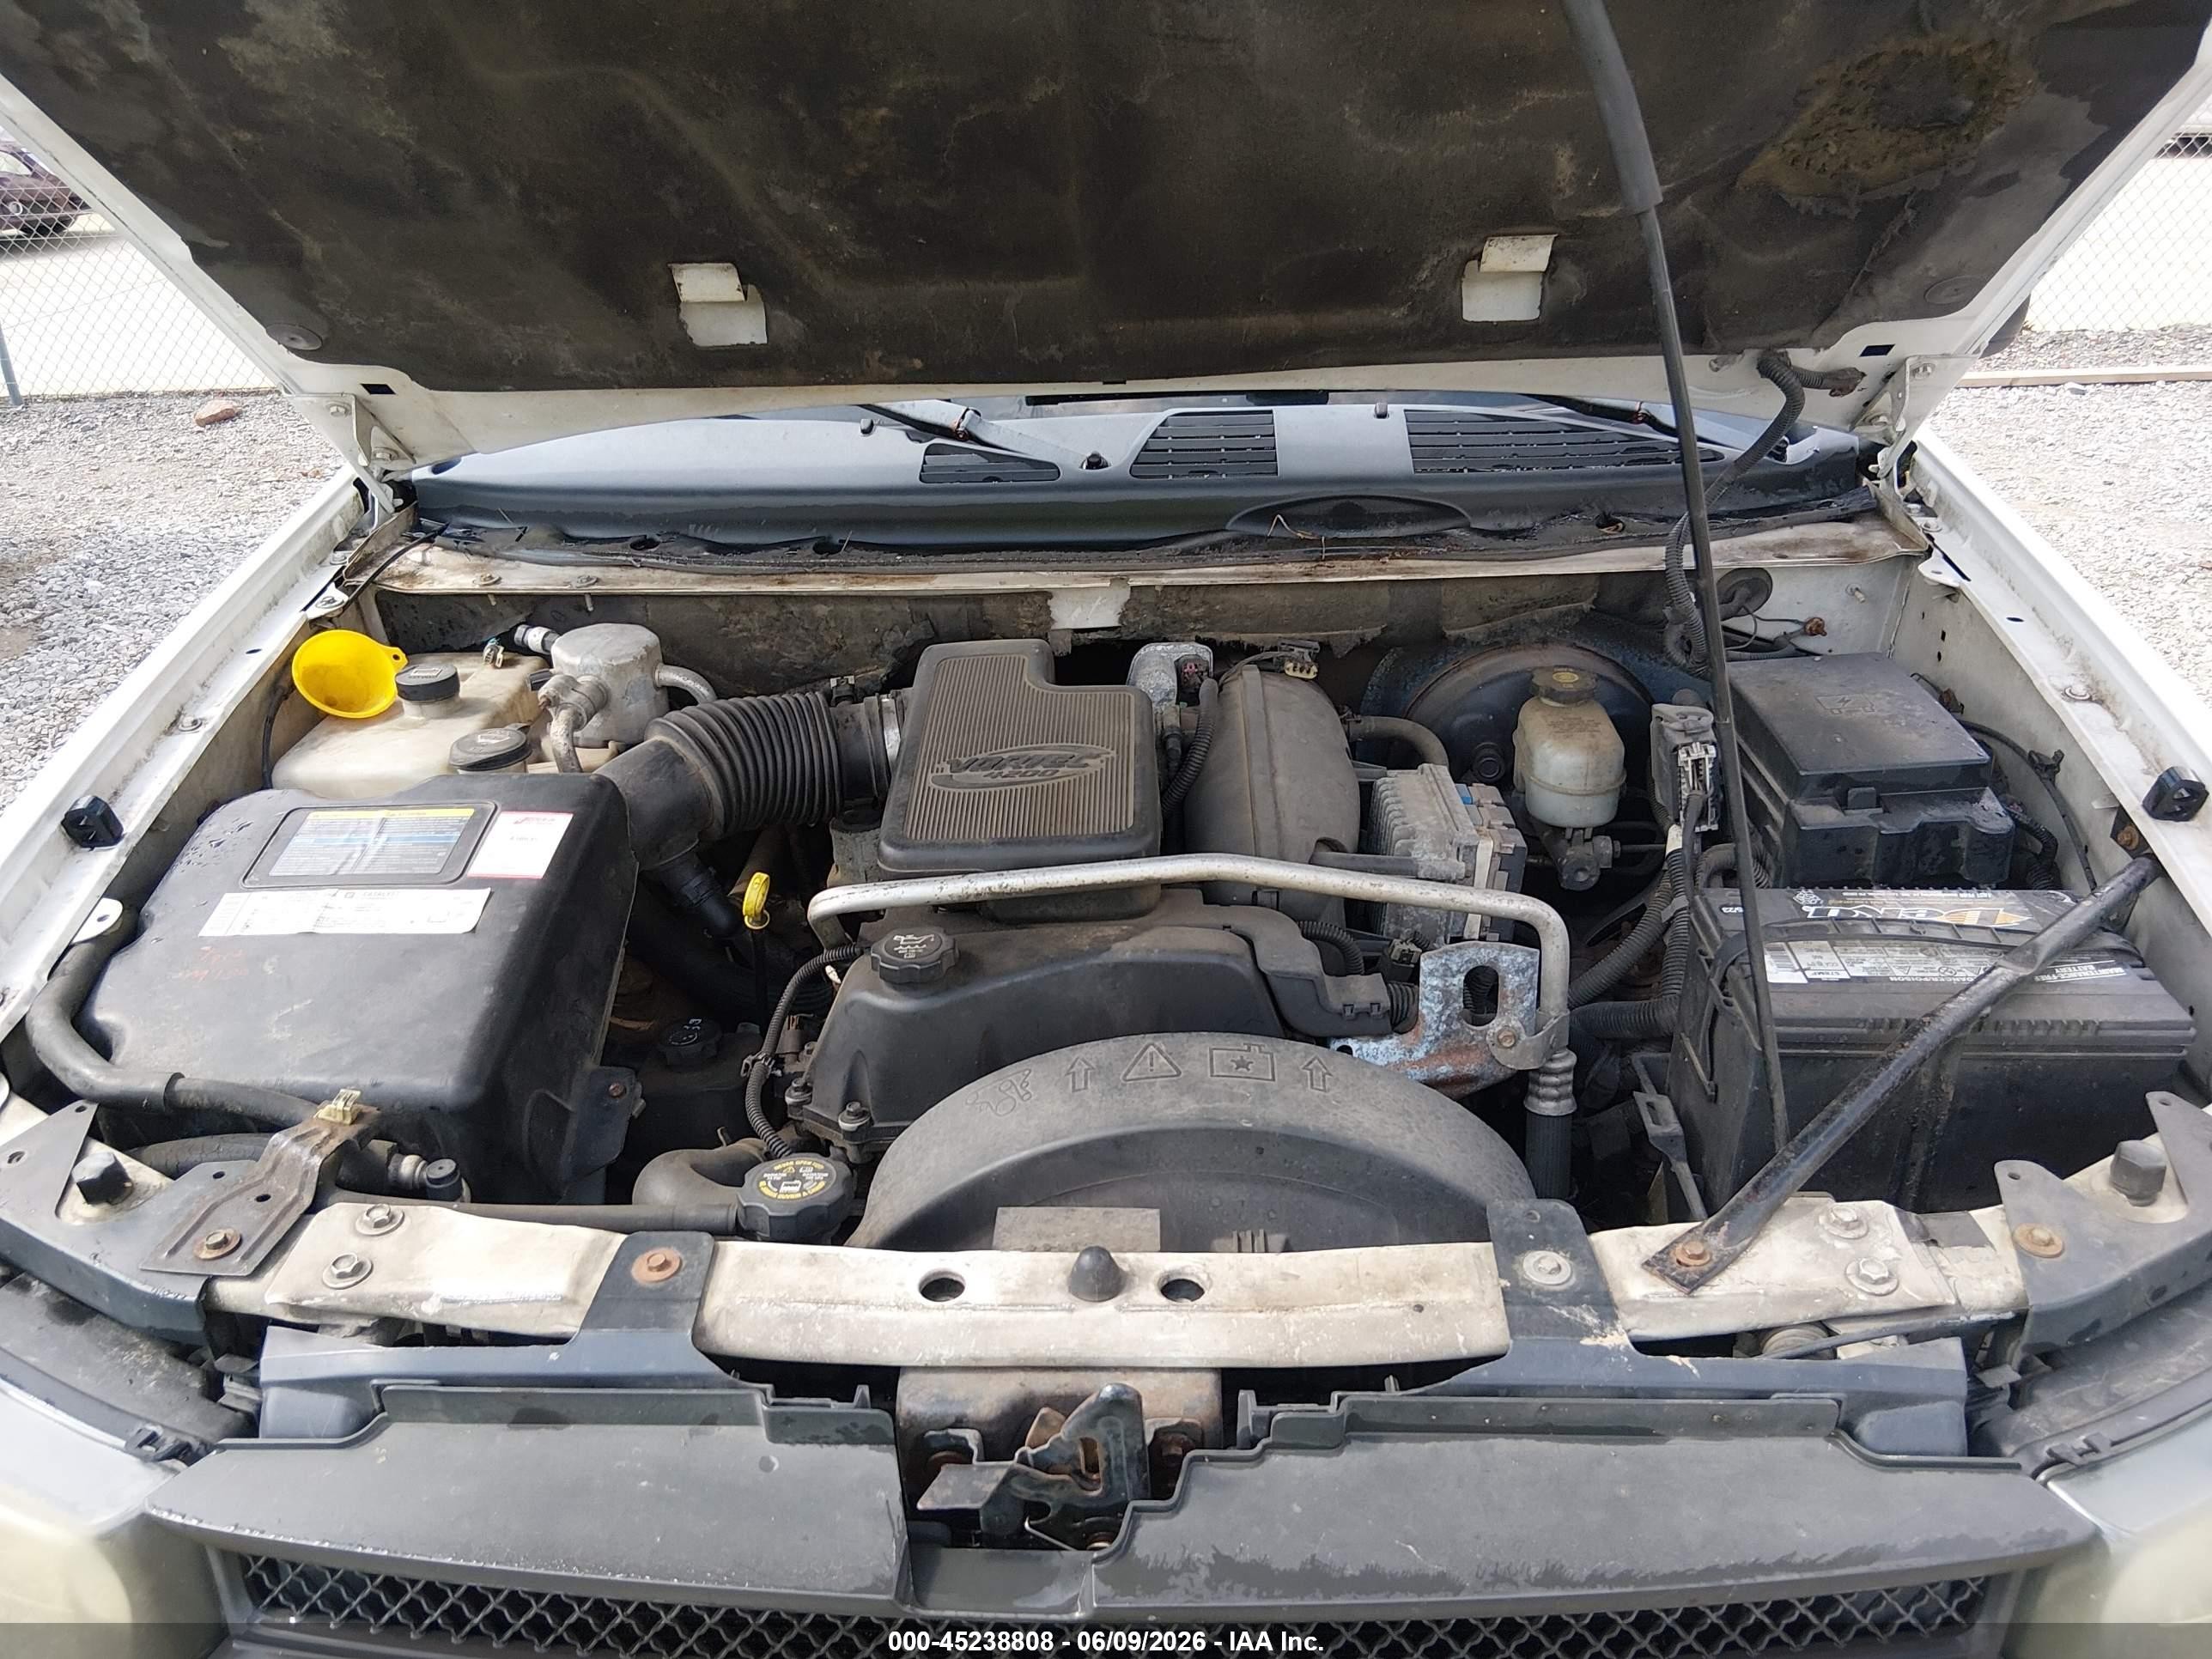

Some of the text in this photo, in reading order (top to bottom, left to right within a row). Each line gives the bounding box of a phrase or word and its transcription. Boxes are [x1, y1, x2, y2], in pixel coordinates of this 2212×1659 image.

[947, 754, 1094, 773] VORTEC
[983, 769, 1060, 779] 4200
[2055, 964, 2095, 974] BATTERY
